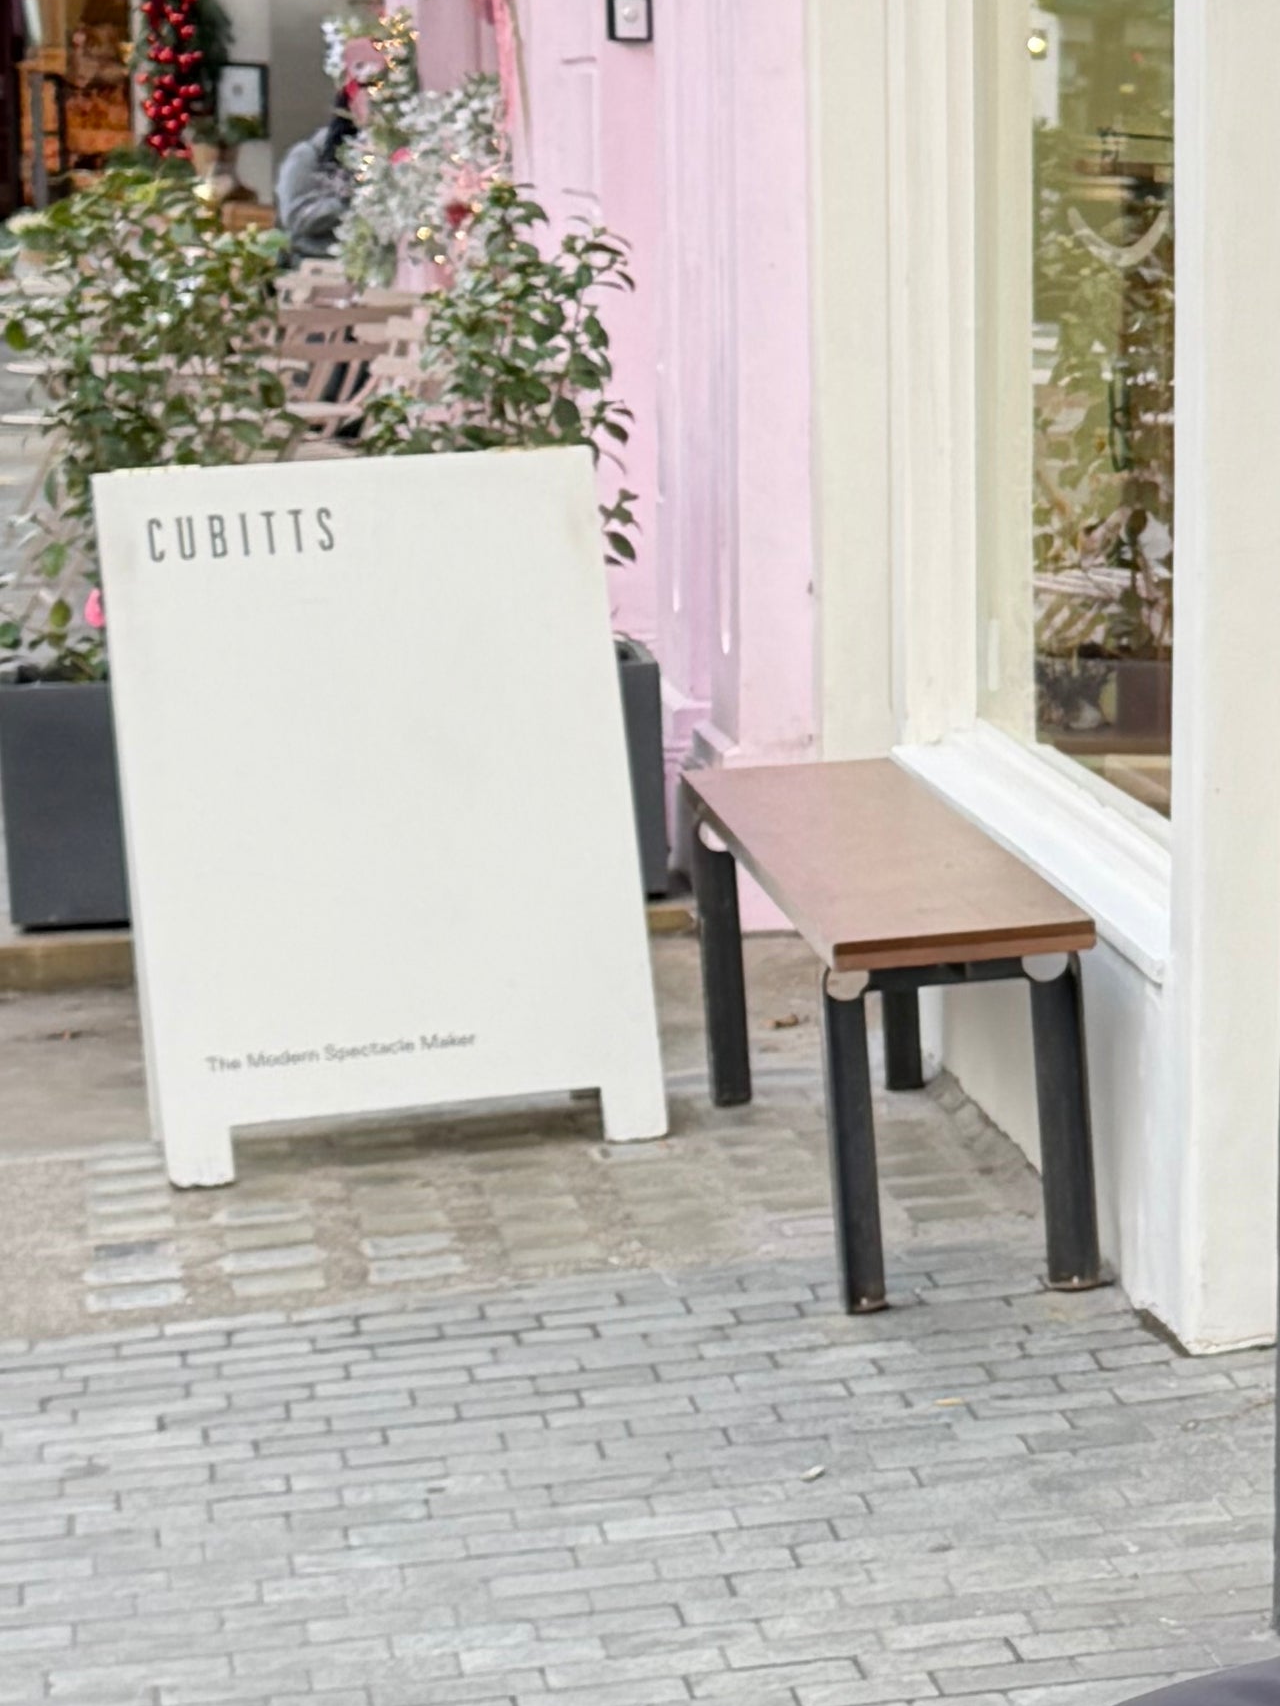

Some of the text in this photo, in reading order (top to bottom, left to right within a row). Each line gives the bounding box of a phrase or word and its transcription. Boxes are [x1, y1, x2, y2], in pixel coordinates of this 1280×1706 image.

[146, 506, 336, 563] CUBITTS
[205, 1032, 478, 1072] The Modern Spectacle Maker
